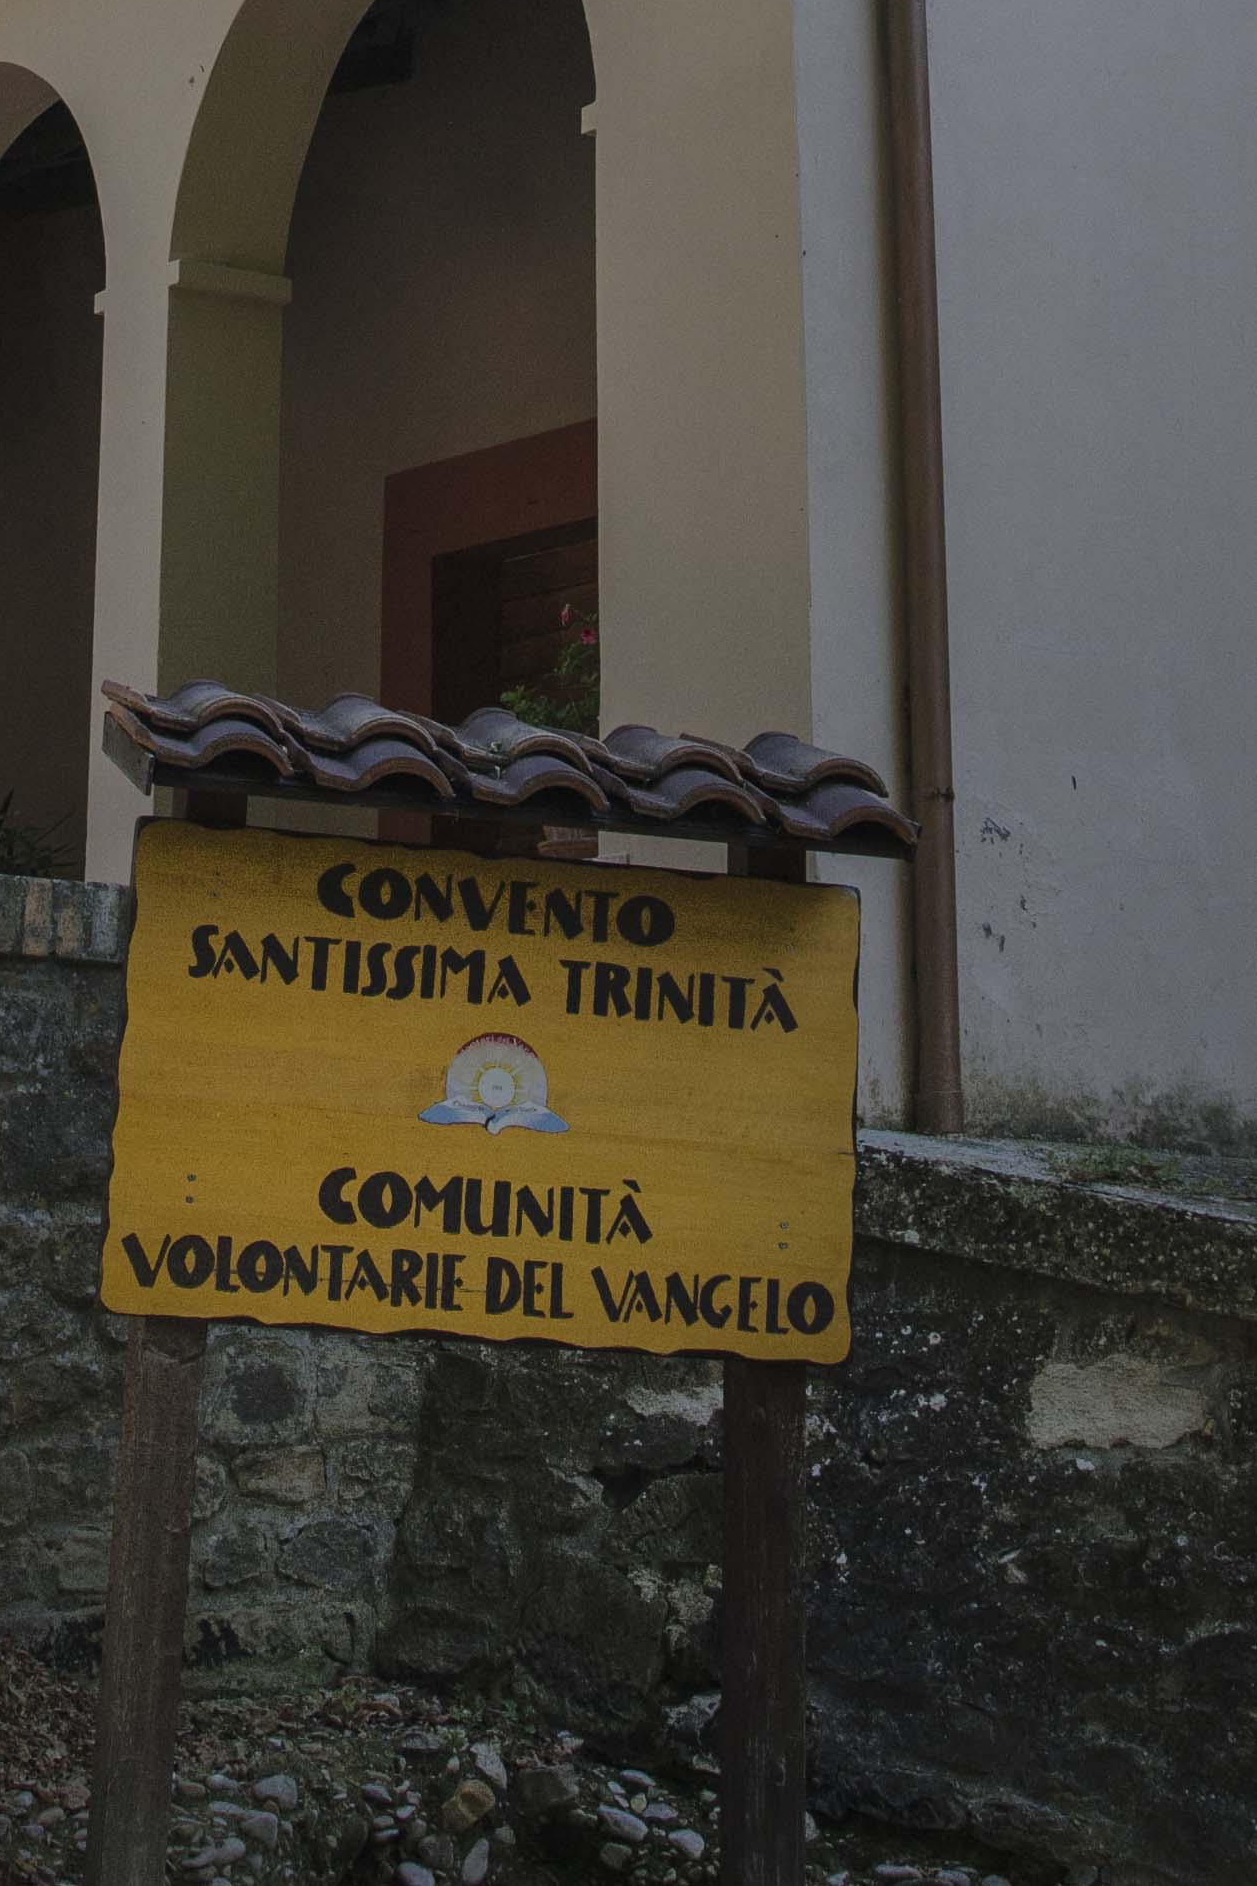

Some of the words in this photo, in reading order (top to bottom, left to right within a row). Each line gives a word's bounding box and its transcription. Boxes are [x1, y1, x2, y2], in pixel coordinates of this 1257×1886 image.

[317, 860, 676, 948] CONVENTO
[188, 925, 532, 1006] SANTISSIMA
[559, 959, 798, 1033] TRINITÀ
[318, 1167, 654, 1244] COMUNITÀ
[122, 1233, 466, 1313] VOLONTARIE
[485, 1256, 574, 1319] DEL
[591, 1266, 835, 1336] VANGELO
